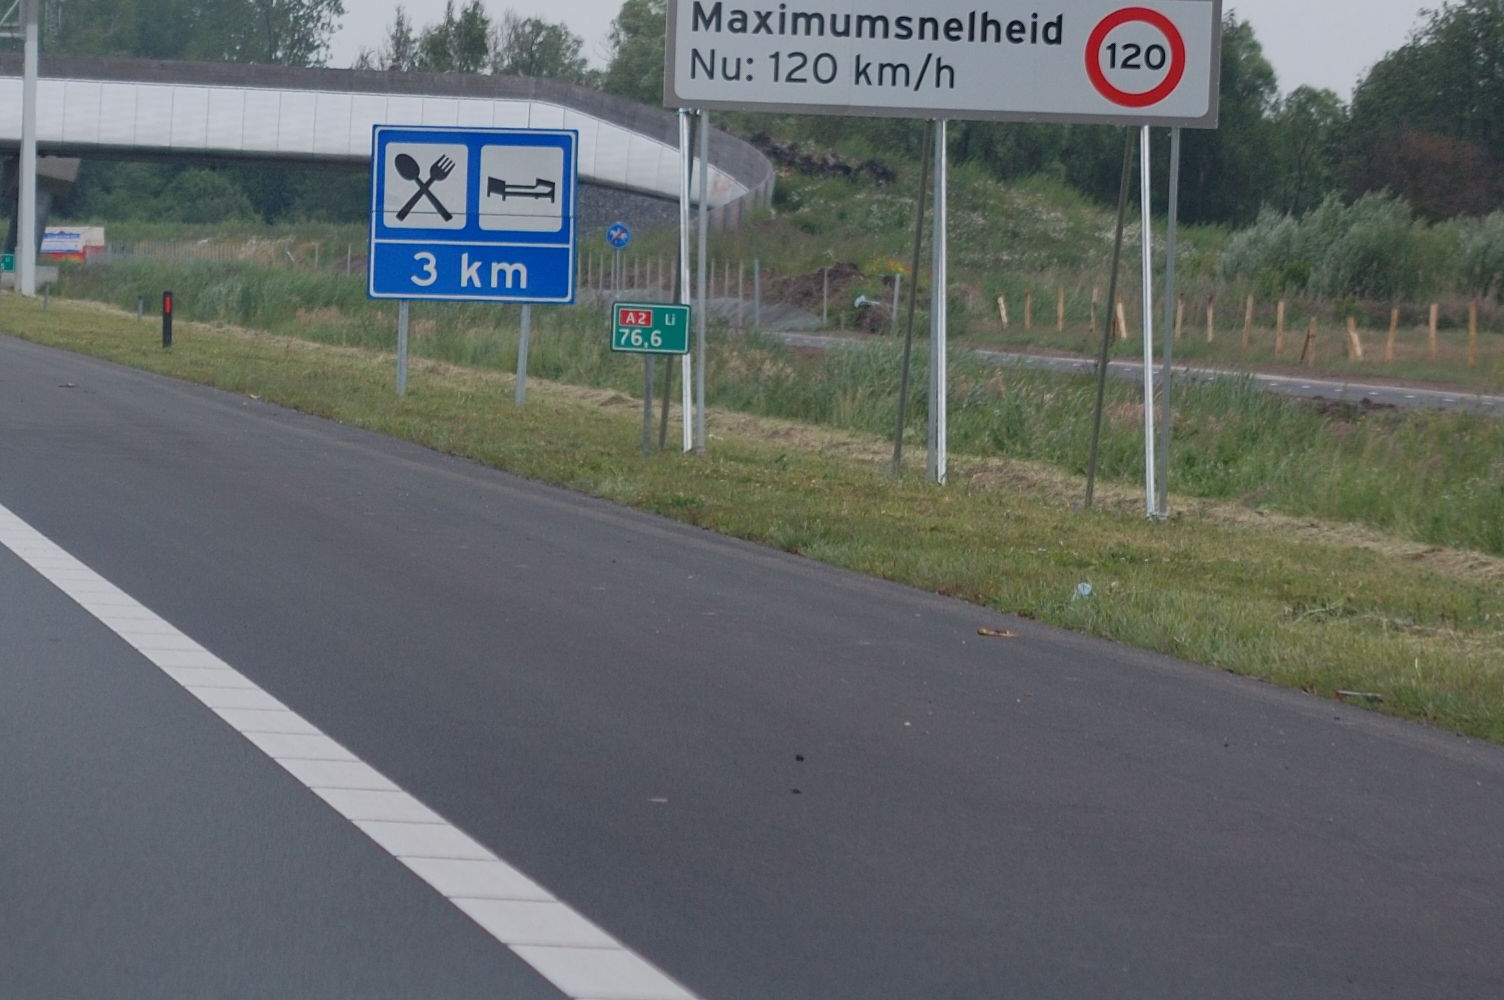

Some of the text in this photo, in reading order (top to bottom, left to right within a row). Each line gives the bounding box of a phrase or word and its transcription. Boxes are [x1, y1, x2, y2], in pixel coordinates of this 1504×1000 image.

[691, 1, 1064, 46] Maximumsnelheid
[690, 48, 956, 91] Nu: 120 km/h
[1105, 43, 1167, 71] 120
[410, 251, 528, 289] 3 km
[625, 311, 647, 325] A2
